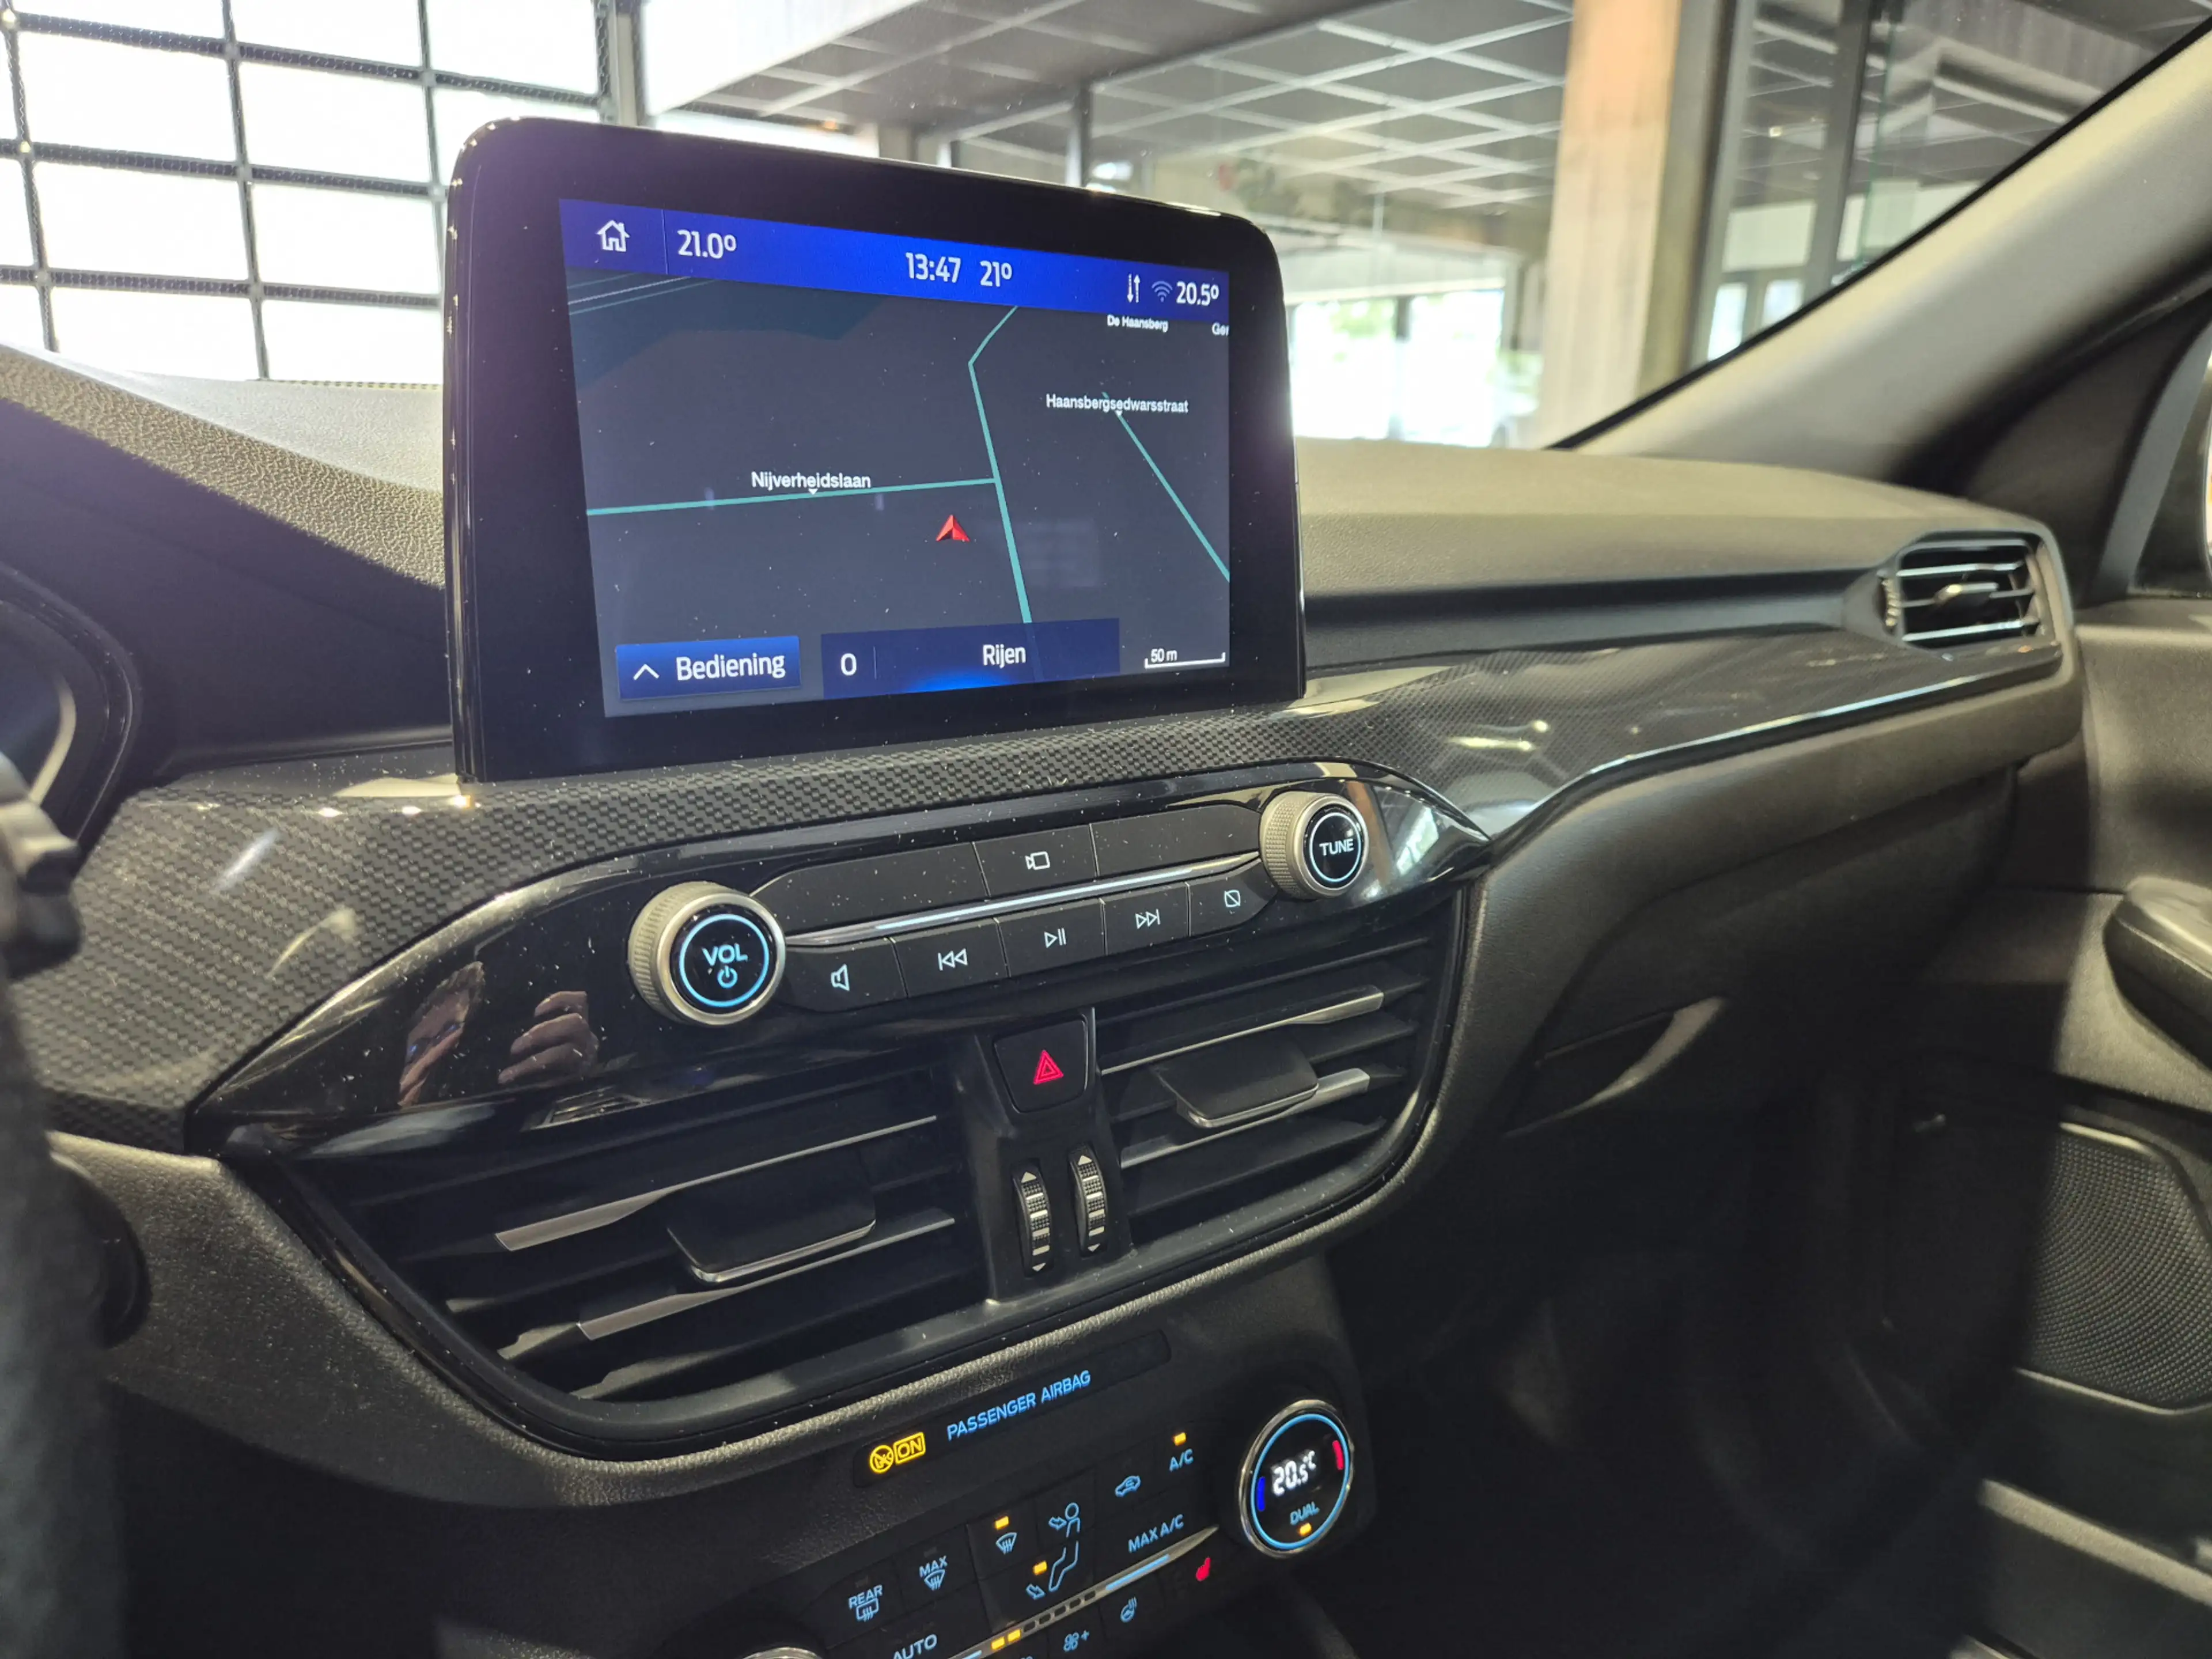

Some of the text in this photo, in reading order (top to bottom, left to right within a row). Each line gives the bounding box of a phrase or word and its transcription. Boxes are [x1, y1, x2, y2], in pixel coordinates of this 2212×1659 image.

[906, 252, 961, 283] 13:47
[1107, 314, 1169, 332] De Haansberg
[1046, 393, 1189, 413] Haansbergsedwarsstraat
[751, 471, 871, 491] Nijverheidslaan
[676, 653, 786, 681] Bediening
[982, 644, 1026, 669] Rijen
[1151, 648, 1177, 662] 50 m
[1319, 838, 1354, 856] TUNE
[701, 943, 748, 966] VOL
[946, 1369, 1091, 1441] PASSENGER AIRBAG
[896, 1438, 922, 1459] ON
[1169, 1448, 1194, 1472] A/C
[1290, 1501, 1320, 1525] DUAL
[1128, 1513, 1184, 1553] MAX A/C
[919, 1555, 948, 1578] MAX
[849, 1584, 883, 1609] REAR
[892, 1634, 938, 1659] AUTO
